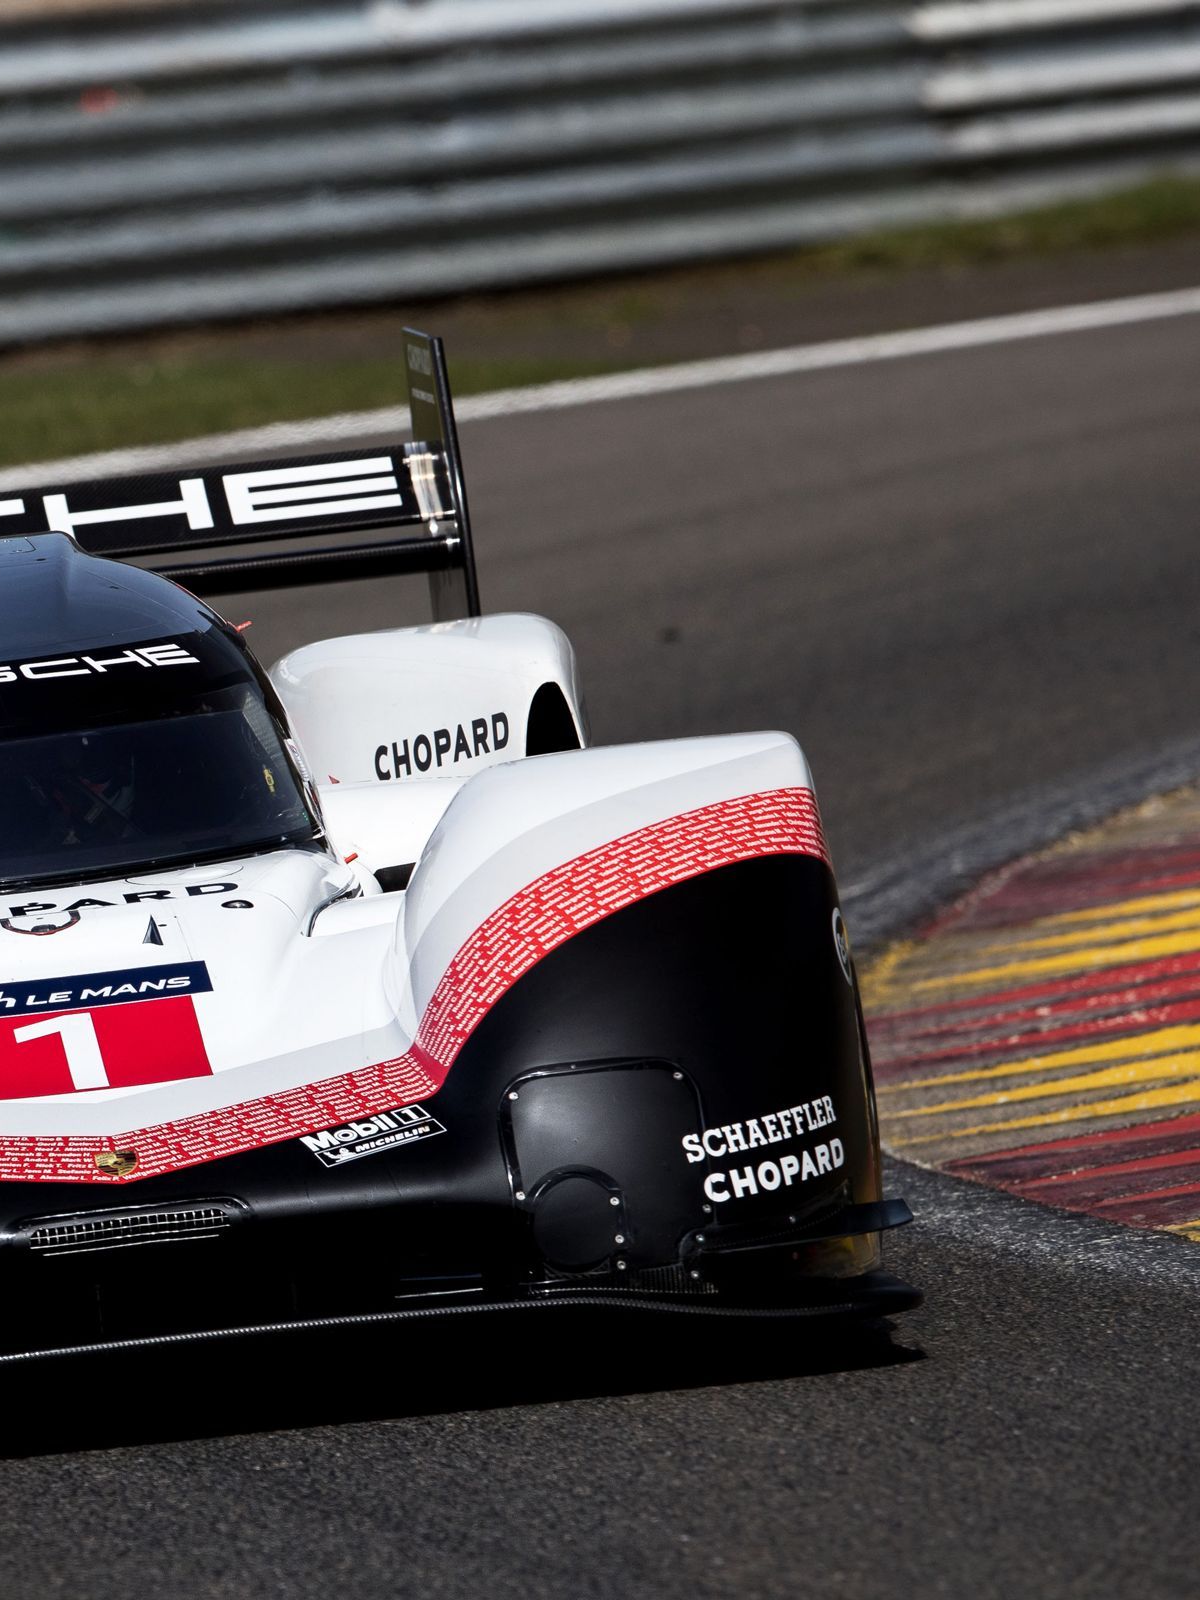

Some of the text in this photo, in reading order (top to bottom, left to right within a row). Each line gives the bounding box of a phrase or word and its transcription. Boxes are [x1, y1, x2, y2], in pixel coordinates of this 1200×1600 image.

[374, 711, 510, 783] CHOPARD
[26, 990, 73, 1005] LE
[80, 976, 192, 1000] MANS
[13, 1012, 110, 1090] 1
[299, 1108, 419, 1153] Mobil 1
[355, 1125, 431, 1153] MICHELIN
[682, 1095, 837, 1163] SCHAEFFLER
[703, 1138, 845, 1203] CHOPARD
